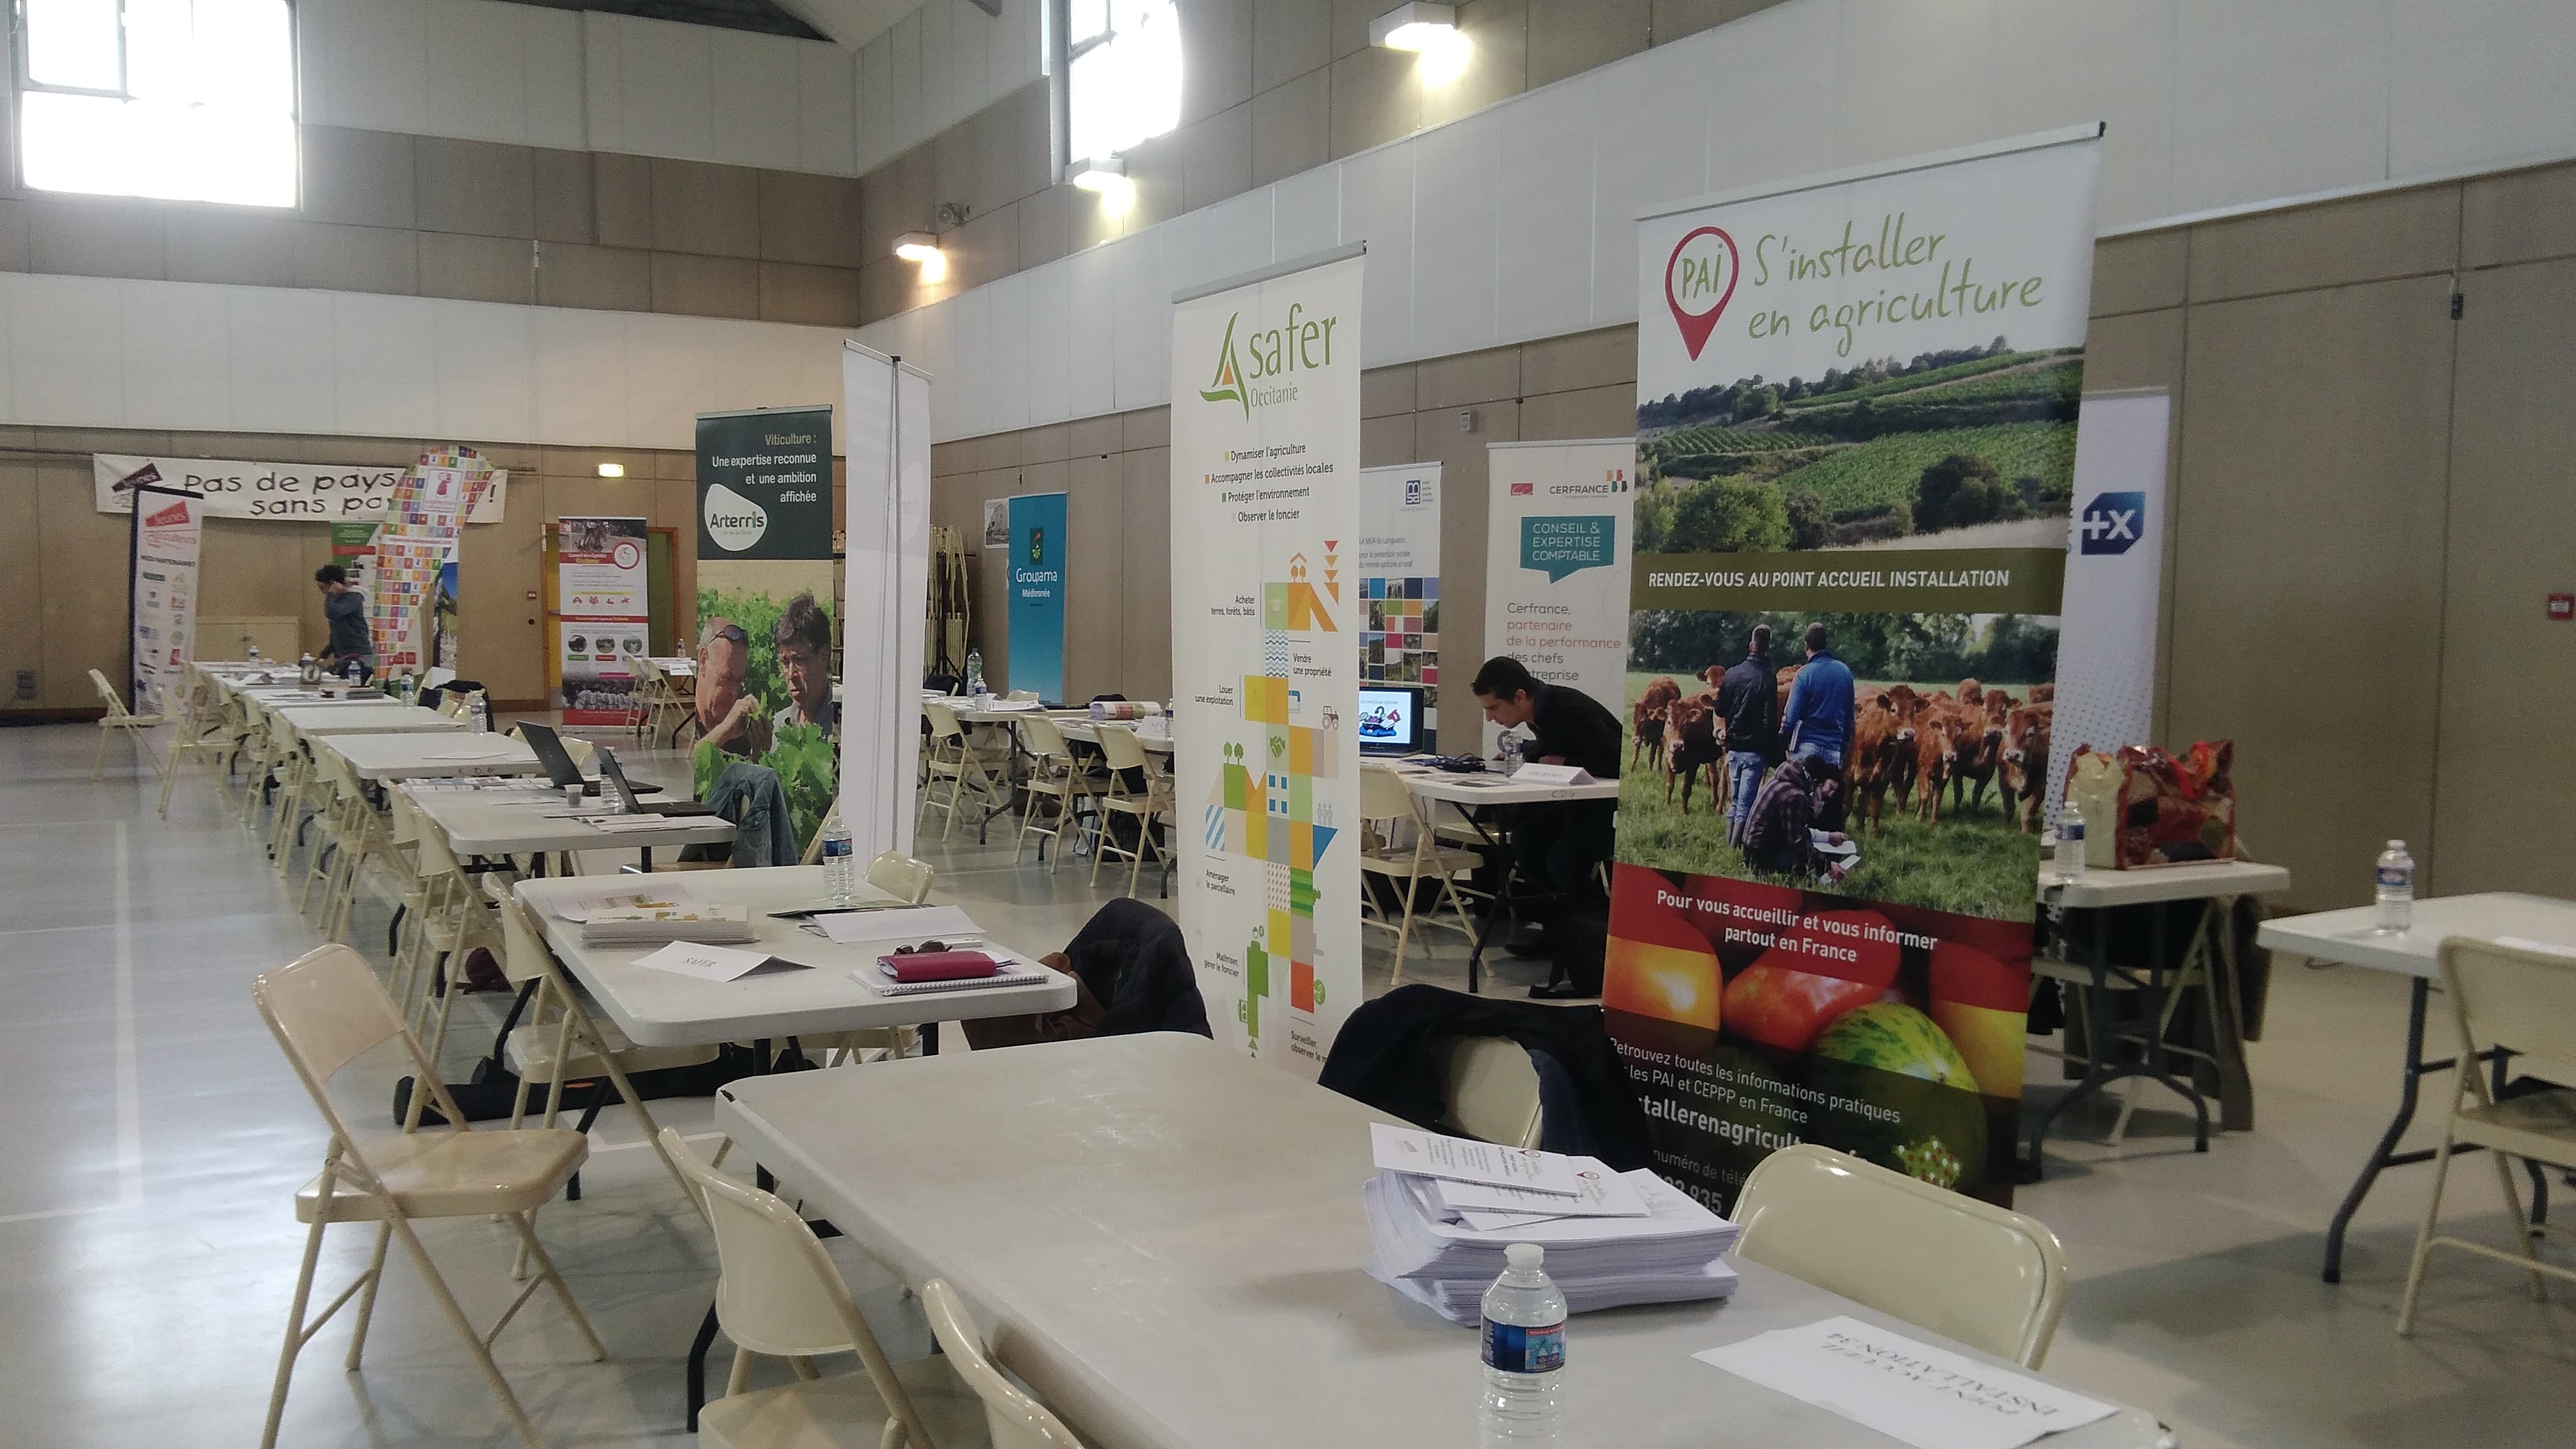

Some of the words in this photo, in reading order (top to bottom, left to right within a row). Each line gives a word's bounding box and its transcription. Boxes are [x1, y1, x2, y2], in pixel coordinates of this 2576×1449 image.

[1753, 211, 1946, 287] S'installer
[1748, 311, 1790, 340] en
[1809, 257, 2044, 358] agriculture
[1249, 303, 1337, 379] safer
[1250, 382, 1299, 408] Occitanie
[765, 433, 811, 446] Viticulture
[1231, 448, 1264, 462] Dynamiser
[1265, 443, 1306, 458] l'agriculture
[712, 455, 730, 467] Une
[731, 454, 772, 468] expertise
[774, 453, 817, 465] reconnue
[745, 473, 755, 484] et
[759, 474, 775, 484] une
[777, 471, 817, 484] ambition
[1211, 471, 1253, 485] Accompagner
[1254, 469, 1263, 480] les
[1265, 465, 1304, 479] collectivités
[1306, 463, 1334, 475] locales
[184, 474, 242, 492] Pas
[256, 471, 300, 491] de
[312, 472, 396, 494] pays
[1549, 485, 1609, 495] CERFRANCE
[780, 491, 817, 502] affichée
[1228, 489, 1255, 504] Protéger
[1256, 486, 1310, 501] l'environnement
[250, 499, 326, 516] sans
[341, 496, 392, 516] pa
[709, 511, 765, 529] Arterris
[1238, 511, 1267, 523] Observer
[1268, 510, 1275, 521] le
[1276, 508, 1299, 521] foncier
[1532, 523, 1586, 535] CONSEIL
[1589, 521, 1601, 535] &
[1532, 536, 1601, 548] EXPERTISE
[1532, 550, 1600, 562] COMPTABLE
[1016, 568, 1058, 586] Groupama
[1648, 572, 1745, 587] RENDEZ-VOUS
[1748, 572, 1768, 587] AU
[1772, 572, 1814, 587] POINT
[1818, 571, 1885, 587] ACCUEIL
[1889, 570, 2009, 587] INSTALLATION
[1235, 595, 1255, 604] Acheter
[1211, 607, 1226, 616] terres,
[1226, 607, 1241, 617] forêts,
[1243, 607, 1255, 616] bâtis
[1507, 602, 1572, 616] Cerfrance,
[1506, 621, 1572, 633] partenaire
[1506, 635, 1522, 647] de
[1525, 635, 1536, 647] la
[1539, 636, 1621, 649] performance
[1293, 653, 1312, 664] Vendre
[1507, 652, 1528, 662] des
[1531, 653, 1563, 664] chefs
[1293, 667, 1304, 675] une
[1304, 667, 1332, 678] propriété
[1219, 684, 1233, 694] Louer
[1195, 695, 1206, 703] une
[1206, 696, 1234, 706] exploitation
[1206, 869, 1229, 883] Aménager
[1206, 879, 1210, 888] le
[1211, 882, 1235, 896] parcellaire
[1657, 889, 1693, 911] Pour
[1696, 898, 1729, 916] vous
[1733, 902, 1800, 929] accueillir
[1802, 914, 1819, 931] et
[1822, 919, 1860, 938] vous
[1864, 925, 1938, 950] informer
[1724, 925, 1775, 949] partout
[1779, 936, 1798, 953] en
[1801, 938, 1857, 963] France
[681, 957, 717, 969] SAFER
[1221, 964, 1239, 977] foncier
[1291, 1043, 1314, 1059] observer
[1629, 1064, 1648, 1082] les
[1652, 1070, 1674, 1087] PAI
[1677, 1078, 1690, 1092] et
[1694, 1079, 1736, 1104] CEPPP
[1739, 1096, 1757, 1111] en
[1760, 1097, 1809, 1124] France
[1675, 1053, 1713, 1077] toutes
[1716, 1063, 1733, 1082] les
[1737, 1069, 1826, 1105] informations
[1829, 1093, 1901, 1123] pratiques
[1638, 1095, 1802, 1151] tallerenagricult
[1702, 1163, 1718, 1179] de
[1864, 1341, 2059, 1418] INSTALLATION
